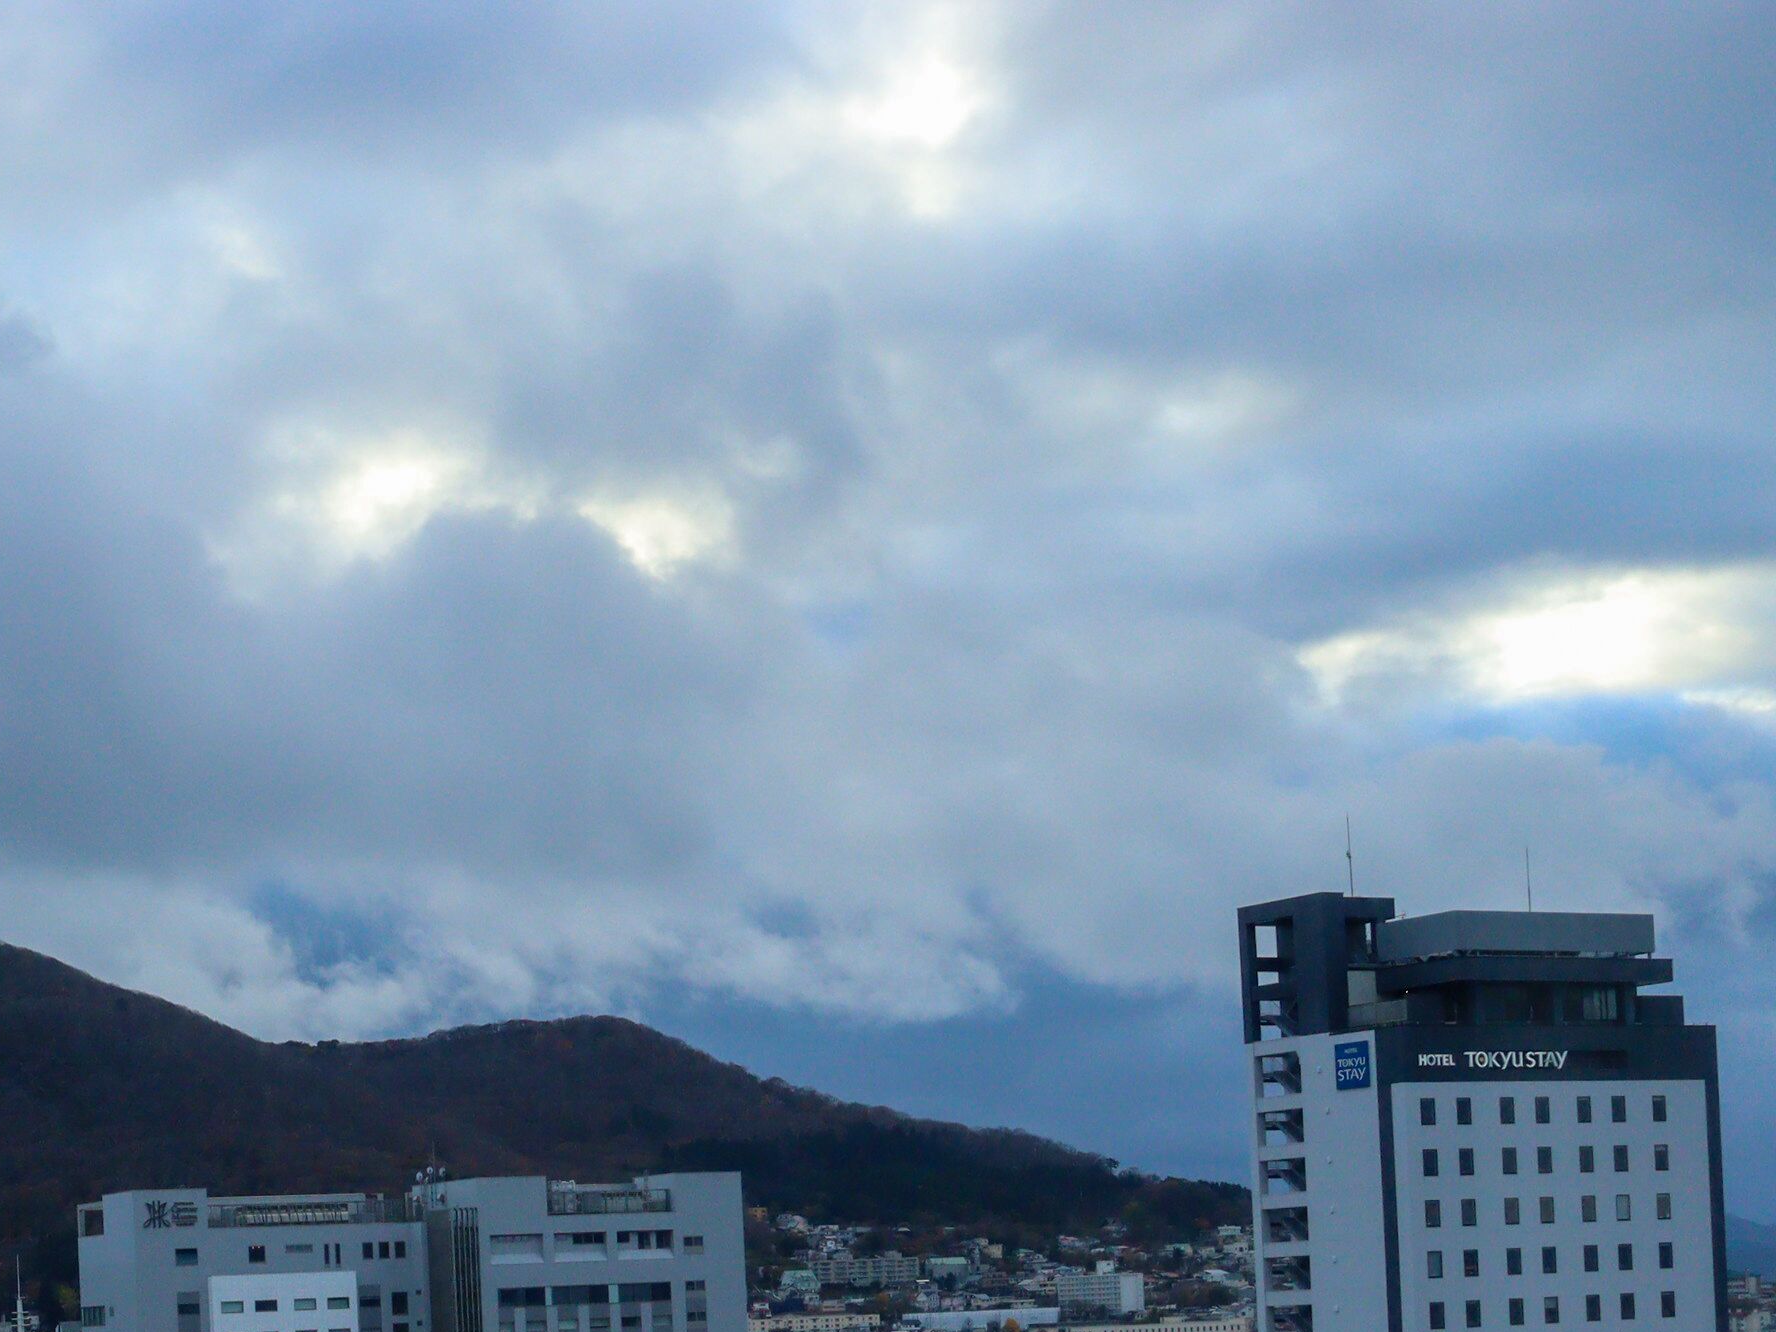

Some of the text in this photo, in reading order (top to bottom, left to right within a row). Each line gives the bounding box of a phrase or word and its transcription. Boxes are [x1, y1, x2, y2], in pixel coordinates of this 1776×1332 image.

[1337, 1056, 1366, 1067] TOKYU
[1418, 1053, 1456, 1067] HOTEL
[1337, 1067, 1366, 1082] STAY
